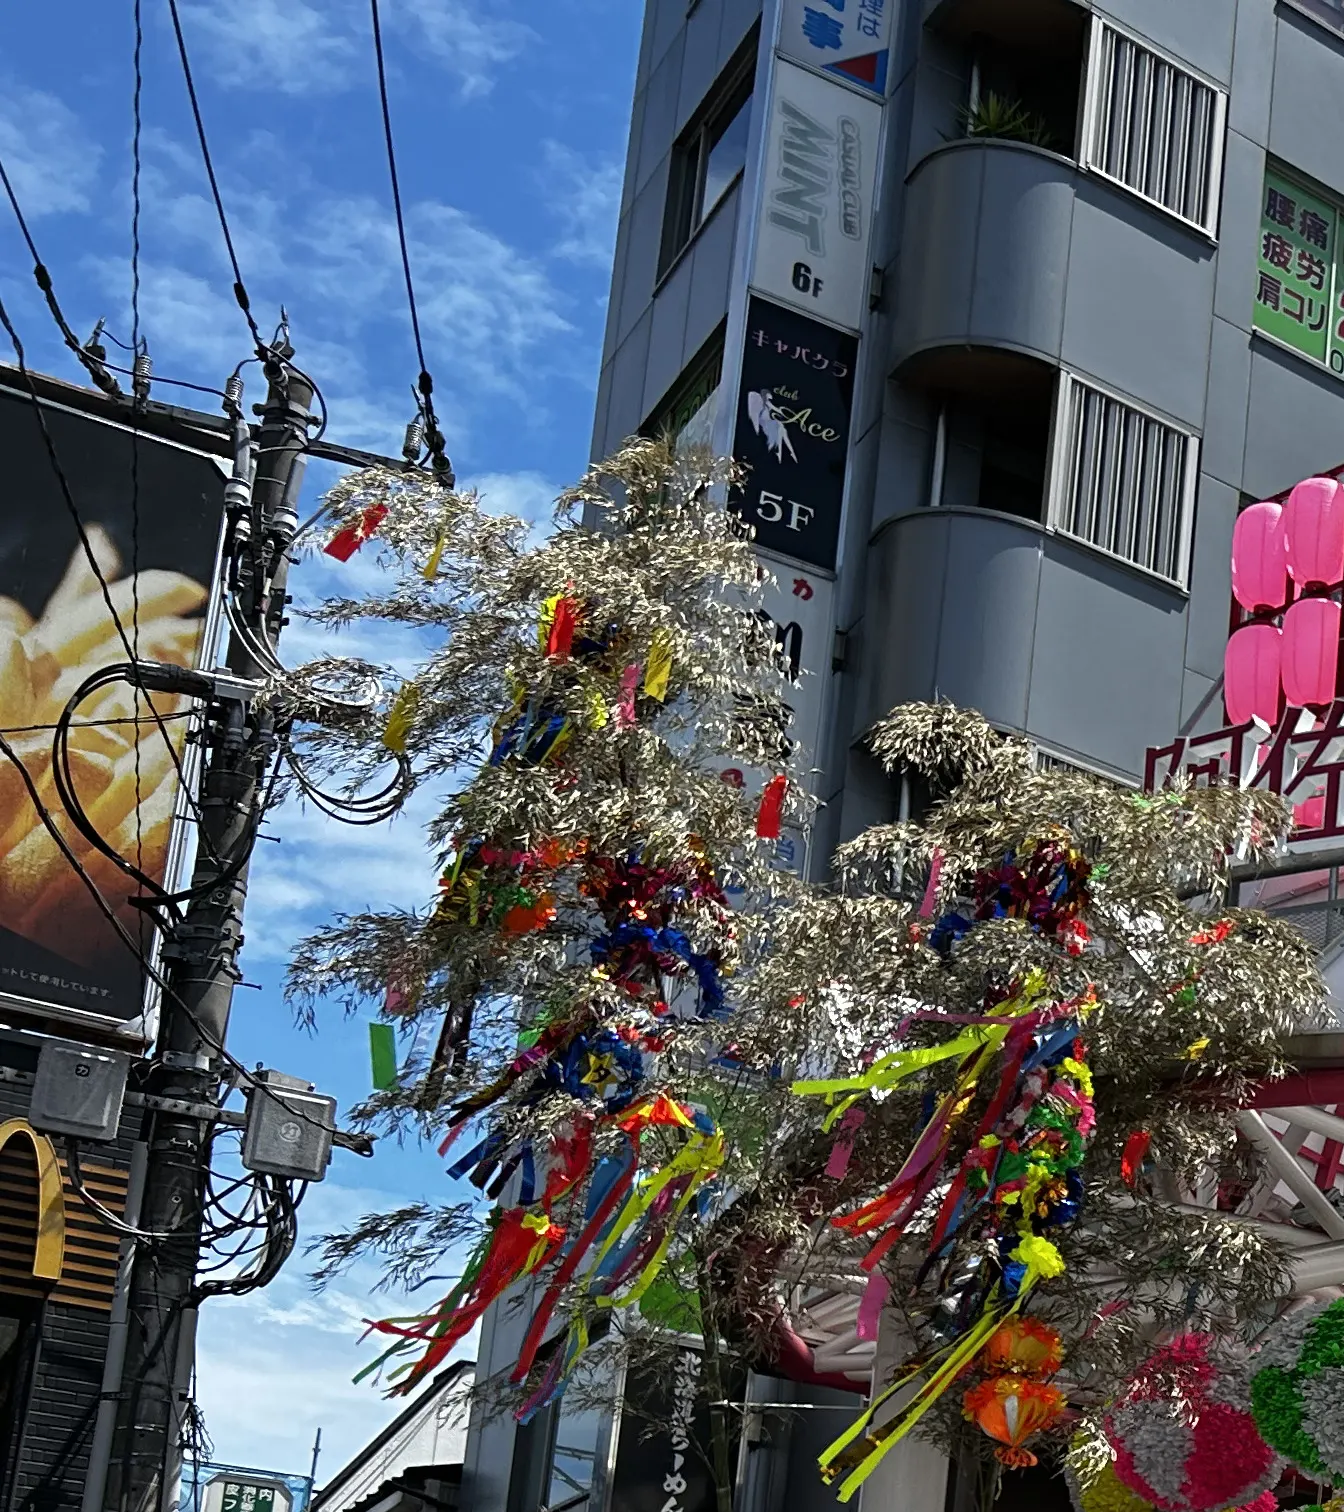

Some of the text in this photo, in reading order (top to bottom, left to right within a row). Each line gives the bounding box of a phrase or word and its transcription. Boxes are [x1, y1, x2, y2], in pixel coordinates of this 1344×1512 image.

[768, 100, 836, 254] MINT
[1265, 187, 1329, 250] 腰痛
[791, 261, 823, 299] 6F
[1262, 231, 1325, 291] 疲労
[1257, 270, 1326, 331] 肩コリ
[752, 330, 848, 378] キャバクラ
[770, 406, 841, 442] Ace
[756, 490, 815, 532] 5F
